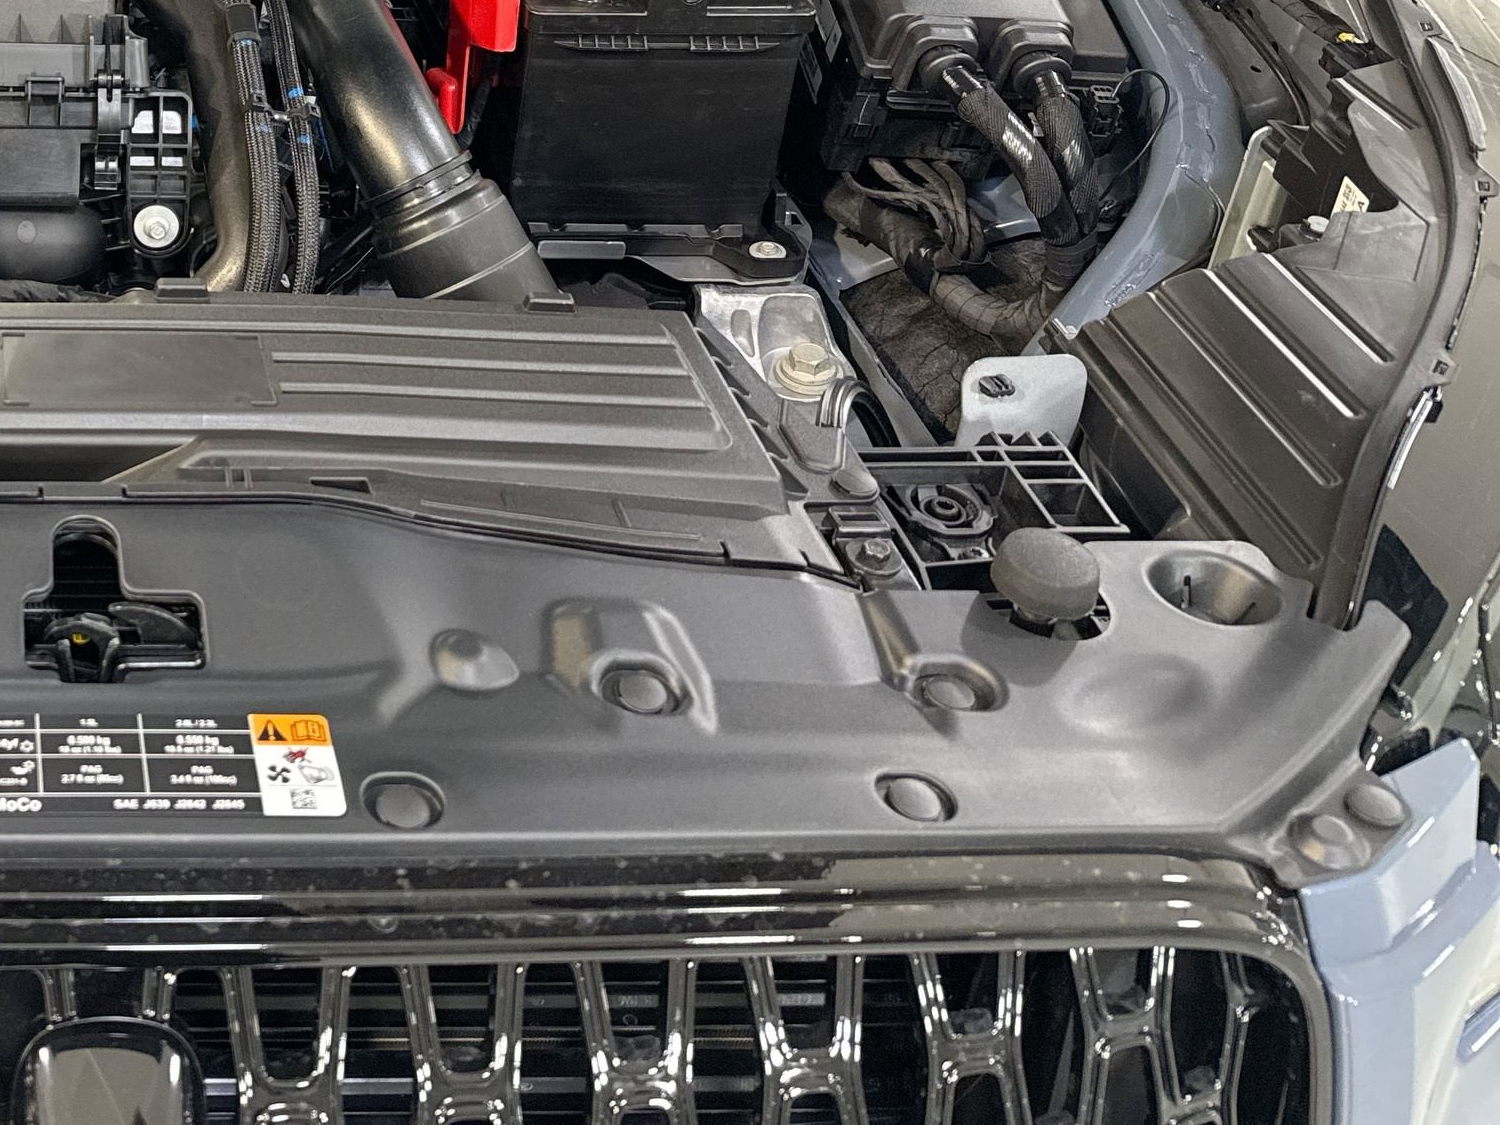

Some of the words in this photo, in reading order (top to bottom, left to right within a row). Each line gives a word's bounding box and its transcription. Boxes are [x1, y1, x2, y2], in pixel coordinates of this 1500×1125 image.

[96, 735, 111, 746] kg
[205, 735, 219, 746] kg
[79, 764, 103, 774] PAG
[191, 765, 213, 774] PAG
[113, 798, 139, 810] SAE
